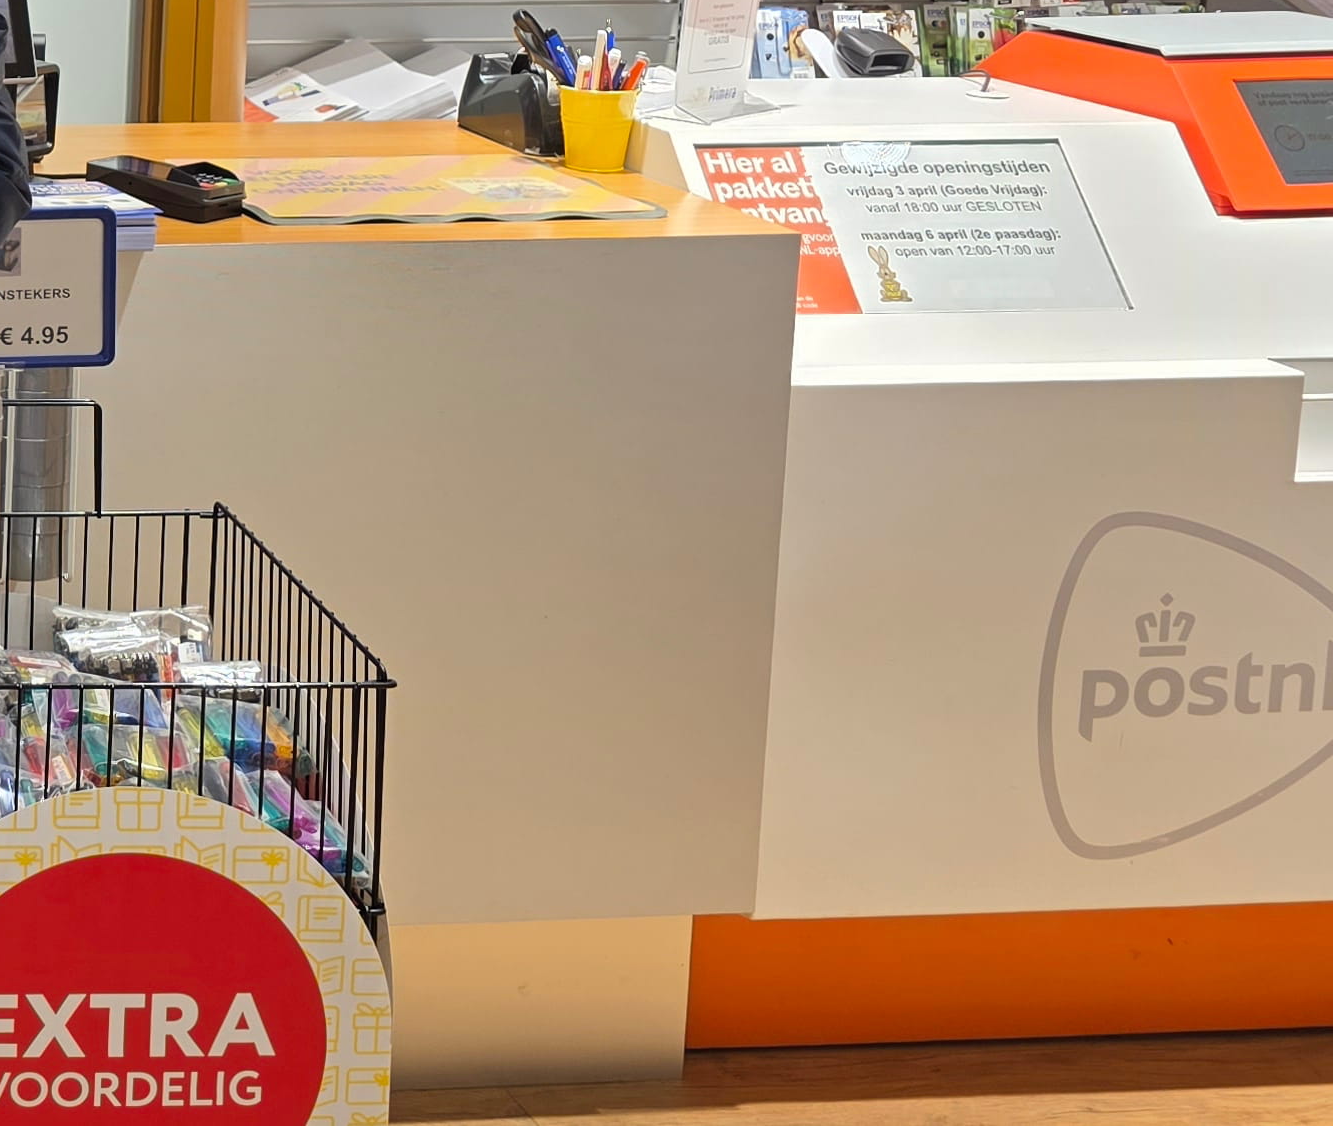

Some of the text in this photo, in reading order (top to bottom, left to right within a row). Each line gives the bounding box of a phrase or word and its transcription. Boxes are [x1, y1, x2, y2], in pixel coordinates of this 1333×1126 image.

[705, 151, 797, 173] Hier al
[823, 160, 1051, 178] Gewijzigde openingstijden
[846, 184, 1048, 199] vrijdag 3 april (Goede Vrijdag):
[866, 201, 1042, 213] vanaf 18:00 uur GESLOTEN
[861, 229, 1062, 243] maandag 6 april (2e paasdag):
[895, 244, 1056, 258] open van 12:00-17:00 uur
[20, 326, 69, 346] 4.95
[1078, 640, 1333, 741] postnl
